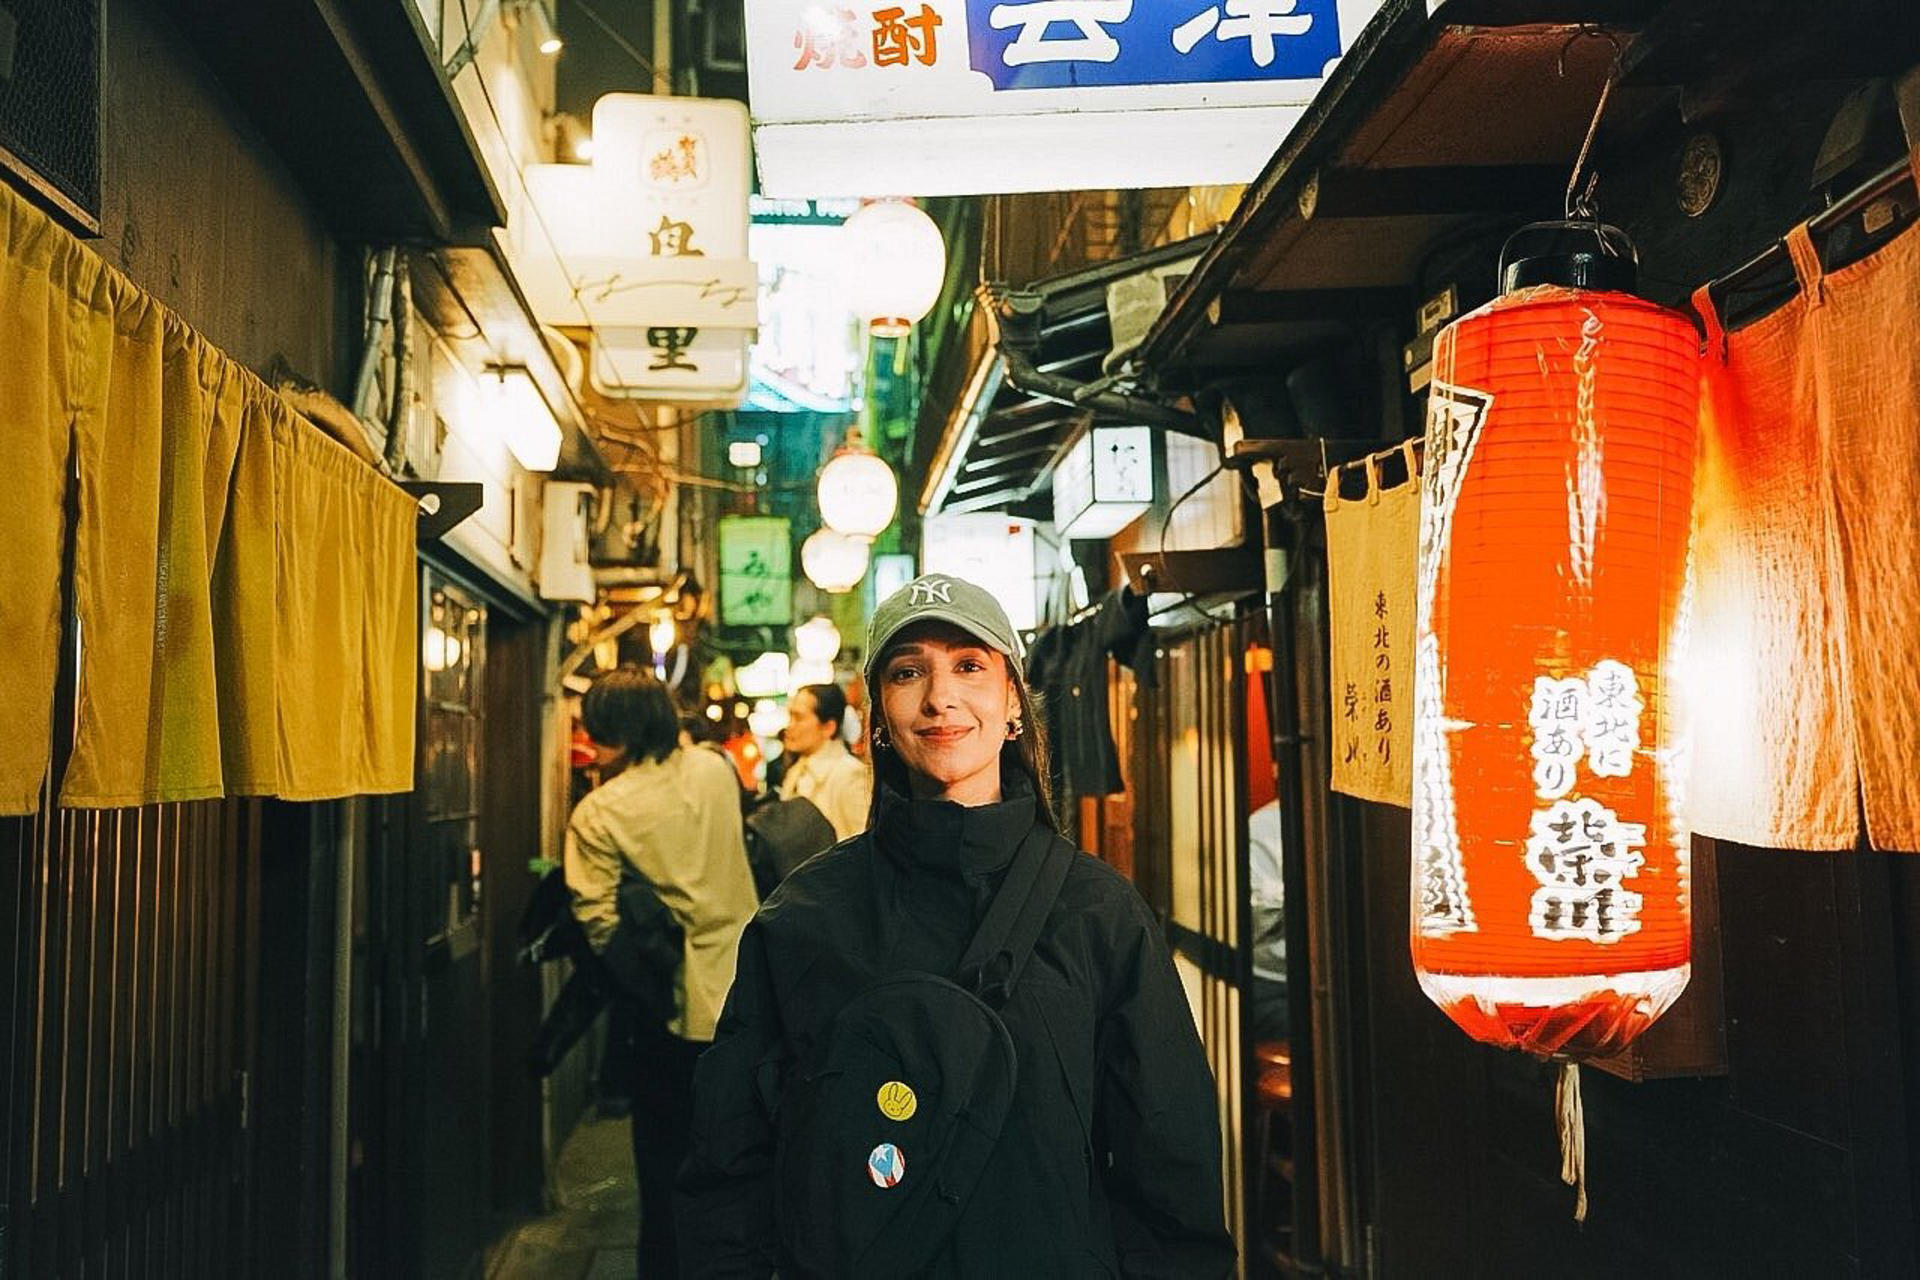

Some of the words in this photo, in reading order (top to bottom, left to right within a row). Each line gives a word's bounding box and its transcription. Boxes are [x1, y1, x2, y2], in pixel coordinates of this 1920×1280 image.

[908, 579, 952, 607] NY
[1373, 588, 1393, 766] 東北の酒あり
[1594, 670, 1633, 769] 東北に
[1540, 687, 1580, 791] 酒あり
